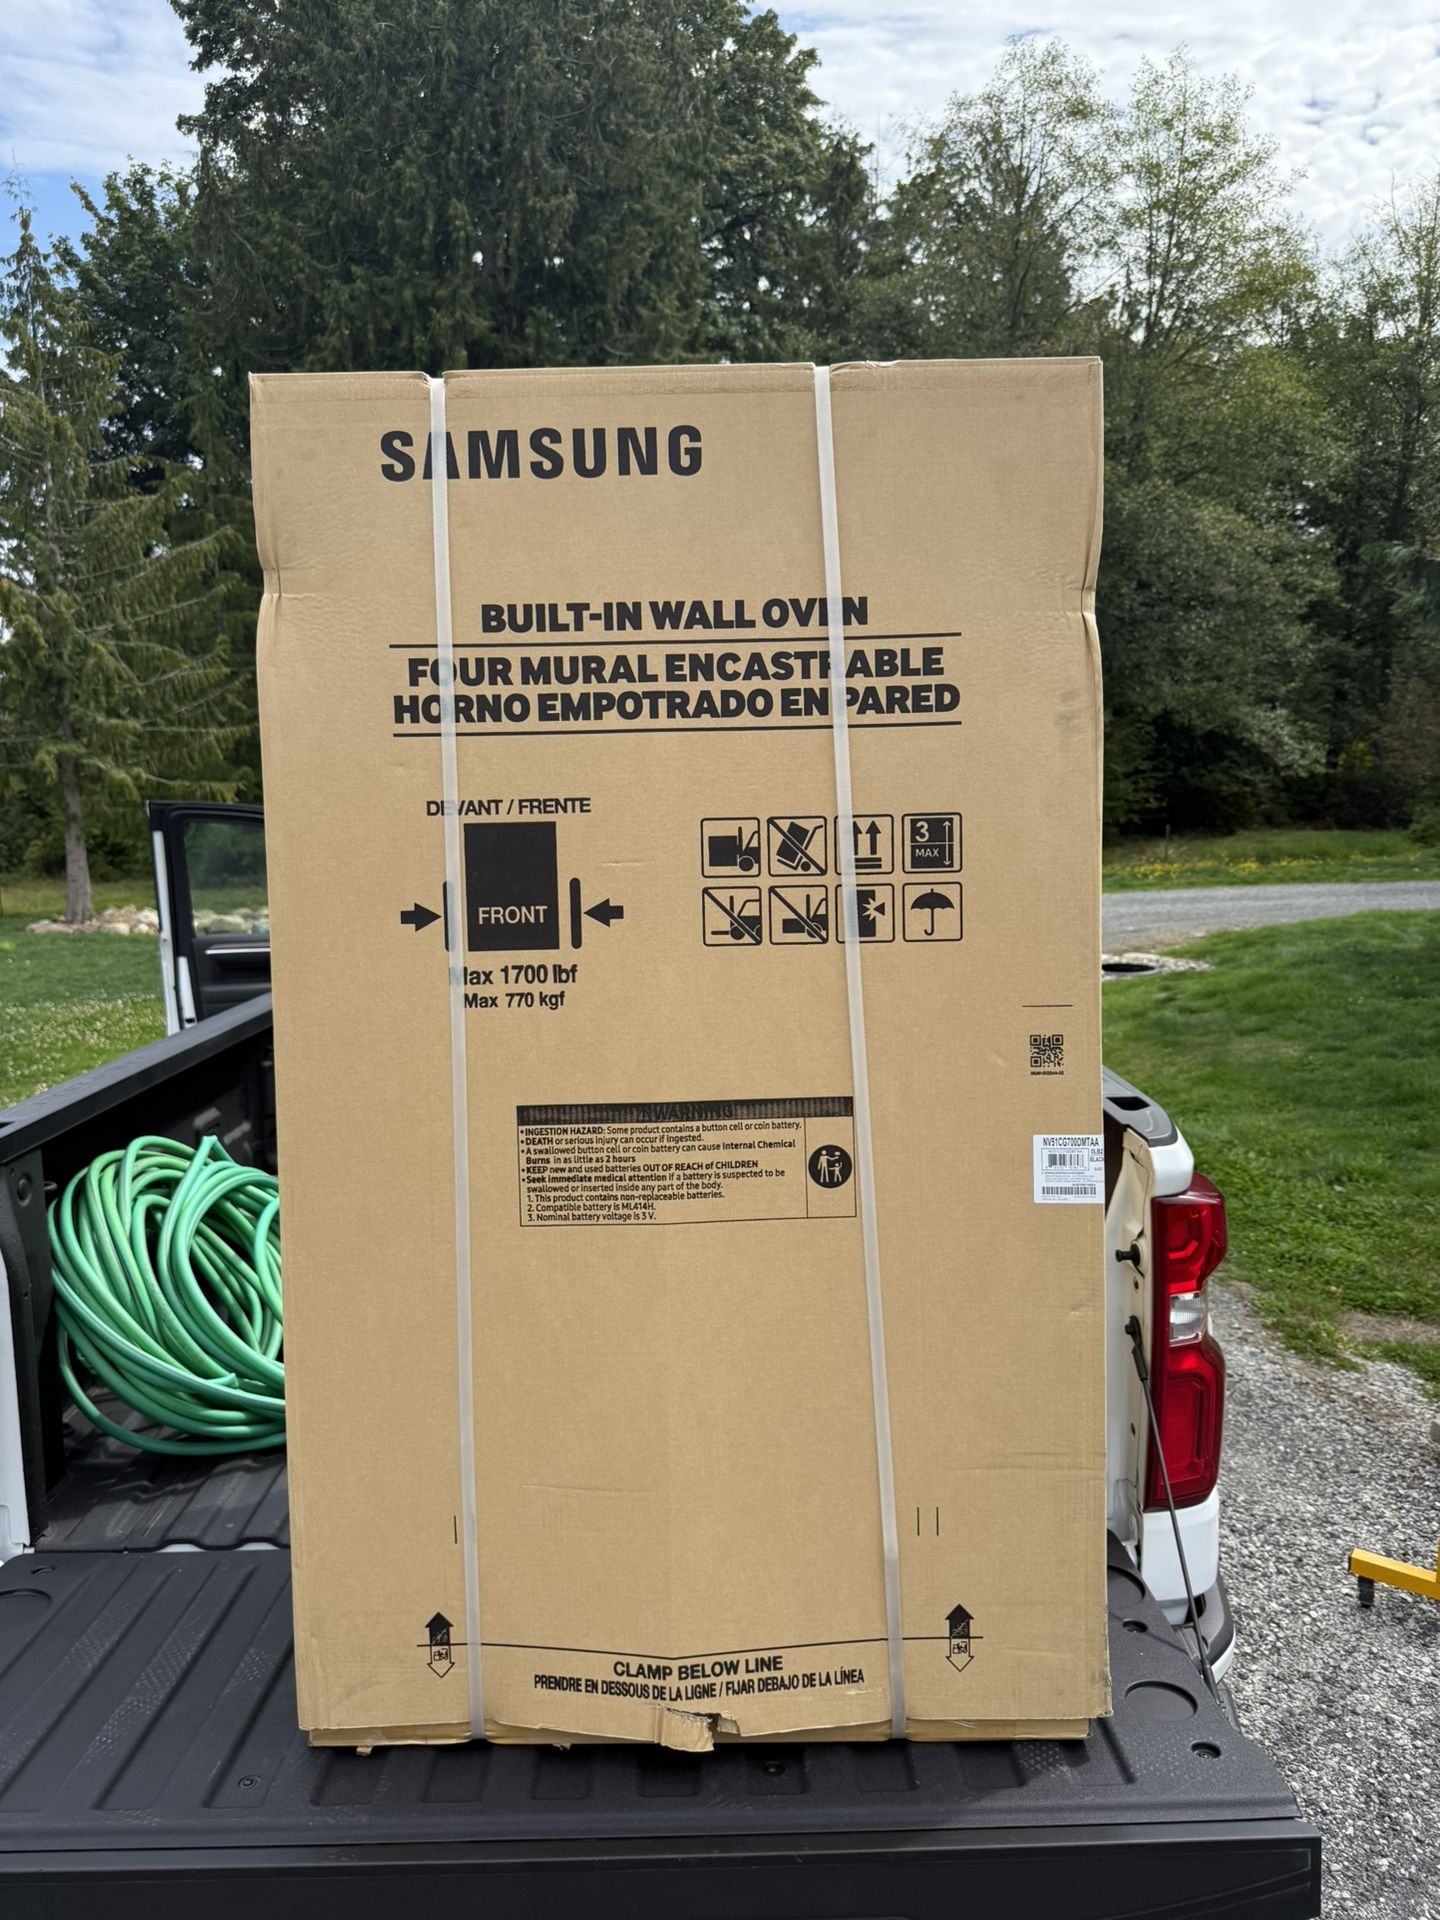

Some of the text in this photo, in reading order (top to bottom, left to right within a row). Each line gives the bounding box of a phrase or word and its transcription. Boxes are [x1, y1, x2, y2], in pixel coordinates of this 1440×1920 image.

[380, 424, 703, 482] SAMSUNG
[481, 601, 643, 633] BUILT-IN
[648, 600, 756, 630] WALL
[408, 657, 514, 687] FOUR
[520, 654, 658, 685] MURAL
[393, 693, 531, 724] HORNO
[537, 688, 774, 722] EMPOTRADO
[780, 687, 829, 717] EN
[426, 799, 503, 816] DVANT
[518, 797, 591, 815] FRENTE
[915, 821, 929, 842] 3
[915, 848, 939, 858] MAX
[478, 905, 548, 924] FRONT
[500, 964, 548, 984] 1700
[552, 964, 578, 984] lbf
[464, 990, 565, 1010] Max 770 kgf
[525, 1128, 568, 1136] INGESTION
[570, 1127, 606, 1135] HAZARD:
[607, 1126, 629, 1134] Some
[630, 1125, 660, 1135] product
[661, 1123, 694, 1133] contains
[702, 1122, 728, 1132] button
[729, 1122, 743, 1131] cell
[754, 1121, 770, 1130] coin
[771, 1120, 802, 1131] battery.
[525, 1137, 553, 1146] DEATH
[565, 1136, 594, 1145] serious
[595, 1135, 618, 1146] injury
[619, 1136, 634, 1144] can
[659, 1134, 666, 1143] if
[666, 1134, 704, 1144] ingested.
[526, 1147, 532, 1155] A
[533, 1145, 575, 1155] swallowed
[577, 1145, 604, 1154] button
[606, 1144, 620, 1153] cell
[632, 1144, 649, 1153] coin
[650, 1143, 681, 1154] battery
[682, 1143, 696, 1151] can
[697, 1143, 721, 1151] cause
[757, 1140, 796, 1149] Chemical
[526, 1156, 550, 1165] Burns
[553, 1156, 562, 1164] in
[574, 1155, 594, 1163] little
[612, 1154, 636, 1162] hours
[526, 1166, 548, 1174] KEEP
[567, 1164, 582, 1173] and
[584, 1164, 603, 1172] used
[605, 1163, 641, 1172] batteries
[643, 1163, 660, 1172] OUT
[661, 1163, 673, 1171] OF
[674, 1162, 703, 1171] REACH
[704, 1161, 714, 1170] of
[715, 1160, 758, 1169] CHILDREN
[526, 1175, 546, 1183] Seek
[594, 1173, 627, 1182] medical
[628, 1172, 667, 1181] attention
[668, 1172, 675, 1181] if
[682, 1171, 713, 1181] battery
[714, 1171, 721, 1179] is
[722, 1169, 763, 1180] suspected
[775, 1168, 785, 1177] be
[527, 1184, 570, 1193] swallowed
[581, 1183, 614, 1192] inserted
[616, 1182, 640, 1191] inside
[641, 1183, 656, 1191] any
[657, 1182, 675, 1192] part
[676, 1181, 684, 1190] of
[686, 1181, 700, 1190] the
[701, 1180, 723, 1190] body.
[527, 1190, 725, 1203] 1. This product contains non-replaceable batteries.
[527, 1204, 534, 1212] 2.
[536, 1203, 581, 1213] Compatible
[582, 1202, 612, 1212] battery
[613, 1202, 620, 1210] is
[528, 1211, 656, 1222] 3. Nominal battery voltage is 3 V.
[613, 1655, 783, 1680] CLAMP BELOW LINE
[534, 1674, 582, 1692] PRENDRE
[584, 1678, 599, 1694] EN
[601, 1680, 650, 1699] DESSOUS
[652, 1685, 666, 1701] DE
[668, 1686, 683, 1701] LA
[685, 1682, 717, 1701] LIGNE
[725, 1679, 755, 1696] FIJAR
[757, 1674, 800, 1693] DEBAJO
[802, 1672, 816, 1688] DE
[818, 1671, 832, 1687] LA
[834, 1666, 865, 1685] LÍNEA
